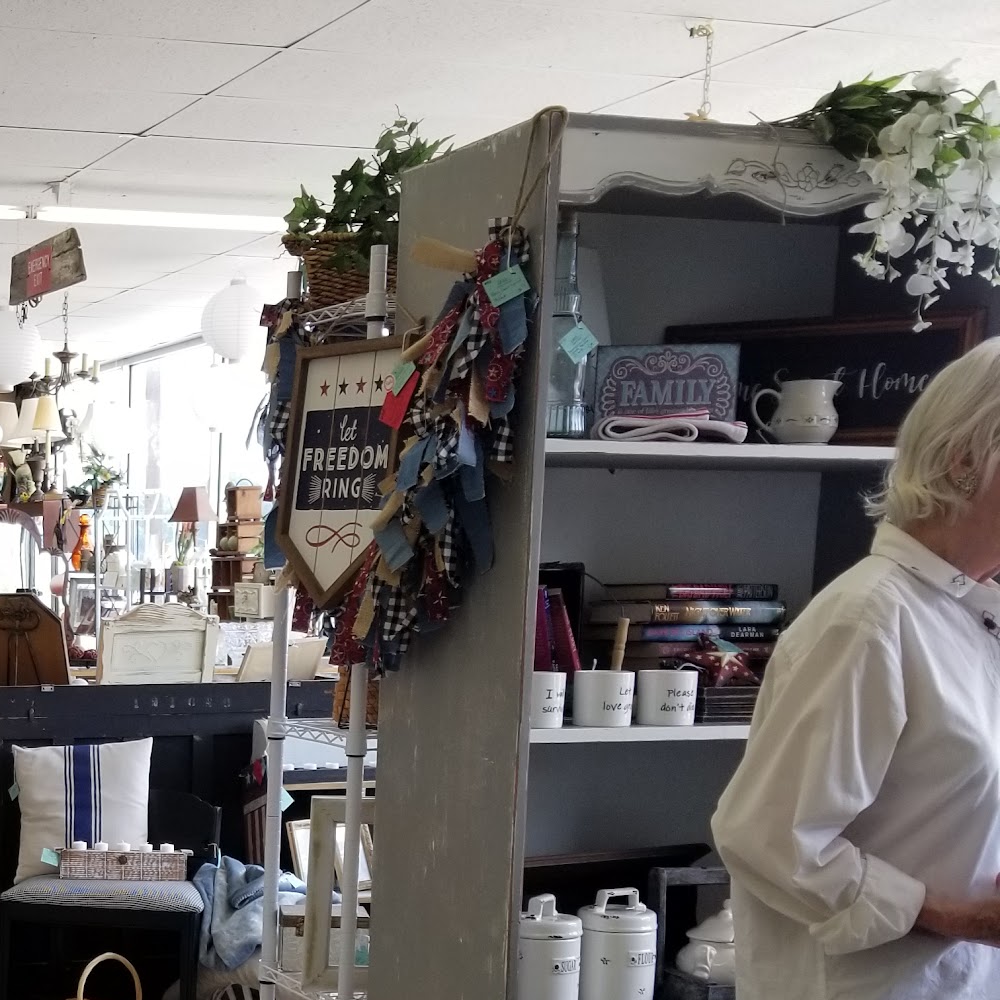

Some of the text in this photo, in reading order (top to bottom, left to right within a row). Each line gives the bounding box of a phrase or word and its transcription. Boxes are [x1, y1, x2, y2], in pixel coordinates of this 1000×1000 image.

[858, 362, 930, 400] Home
[620, 378, 719, 407] FAMILY
[302, 444, 389, 473] FREEDOM
[320, 477, 362, 500] RING
[654, 604, 670, 613] KEN
[545, 688, 553, 699] I
[667, 688, 694, 698] Please
[602, 701, 622, 711] love
[660, 702, 685, 712] don't
